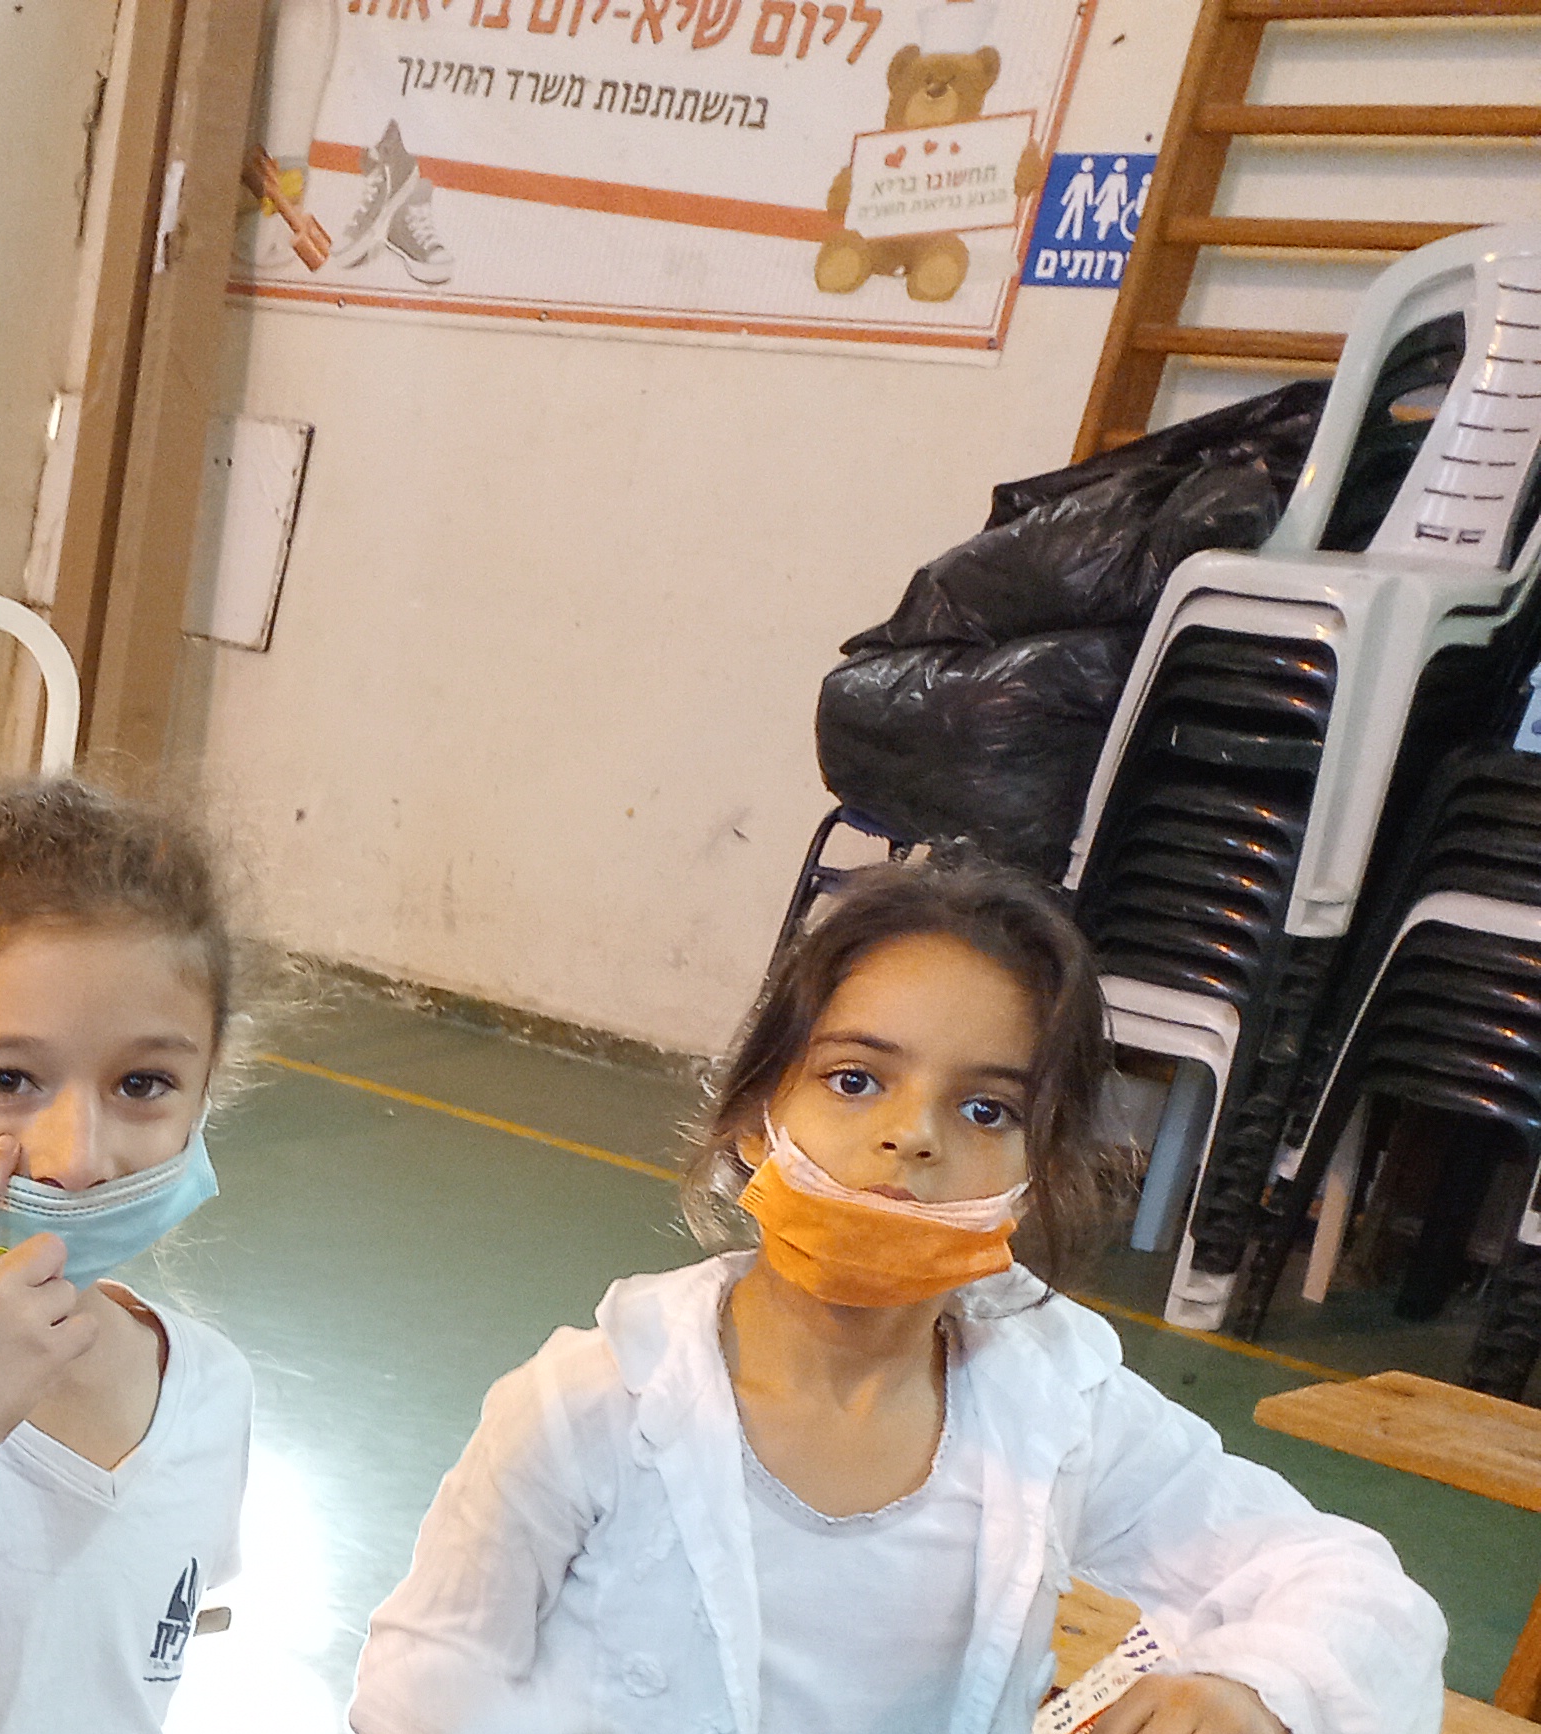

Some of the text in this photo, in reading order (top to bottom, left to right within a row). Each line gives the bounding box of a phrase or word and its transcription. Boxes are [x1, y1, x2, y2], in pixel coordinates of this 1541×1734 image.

[398, 56, 768, 129] בהשתתפות משרד החינוך
[1035, 249, 1130, 280] רותים
